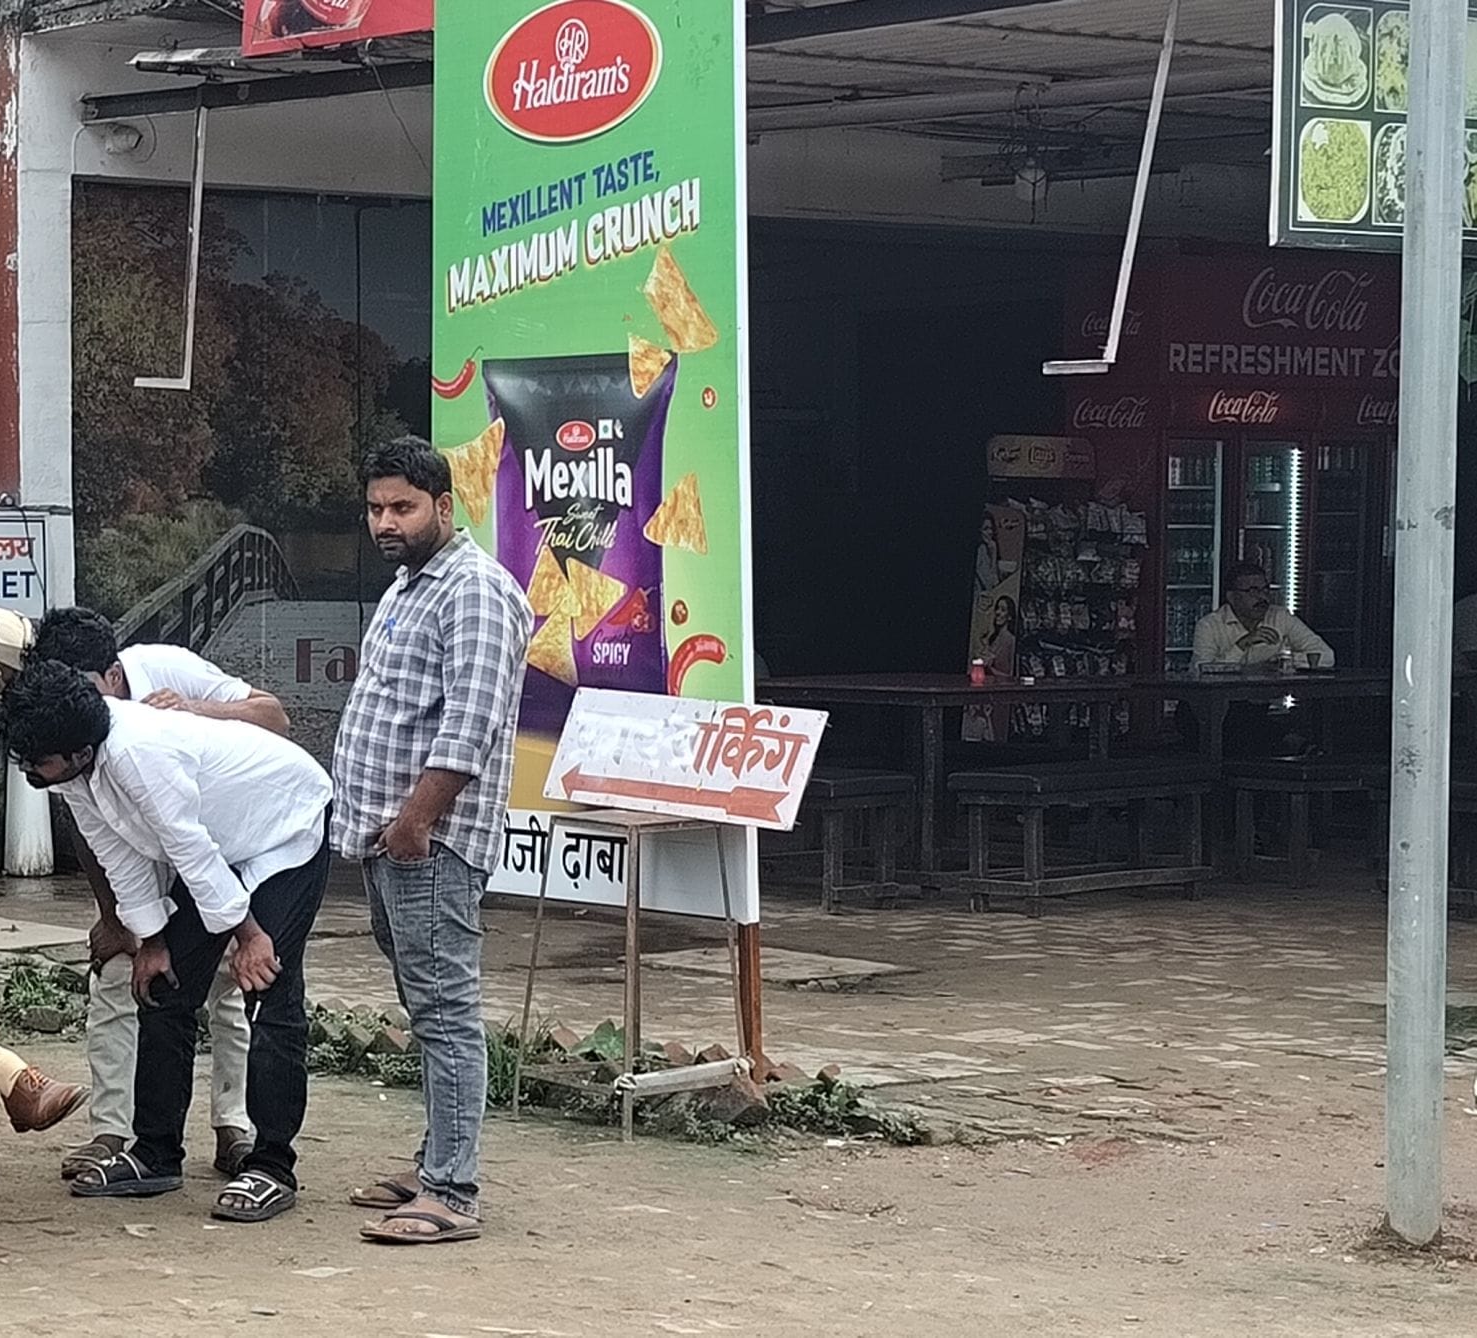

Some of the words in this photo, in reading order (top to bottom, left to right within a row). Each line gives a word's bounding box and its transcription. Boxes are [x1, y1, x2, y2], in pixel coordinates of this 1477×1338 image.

[512, 56, 630, 112] Haldiram's
[482, 173, 586, 238] MEXILLENT
[592, 150, 661, 199] TASTE,
[446, 219, 578, 313] MAXIMUM
[584, 178, 701, 265] CRUNCH
[1242, 266, 1376, 332] Coca-Cola
[1169, 342, 1365, 378] REFRESHMENT
[1073, 396, 1150, 429] Coca-Cola
[1207, 389, 1281, 424] Coca-Cola
[525, 447, 633, 510] Mexilla
[533, 516, 575, 556] Thai
[575, 520, 618, 552] Chilli
[562, 502, 605, 526] Sweet
[296, 638, 358, 683] Fa
[592, 642, 632, 666] SPICY
[692, 706, 811, 787] ार्किंग
